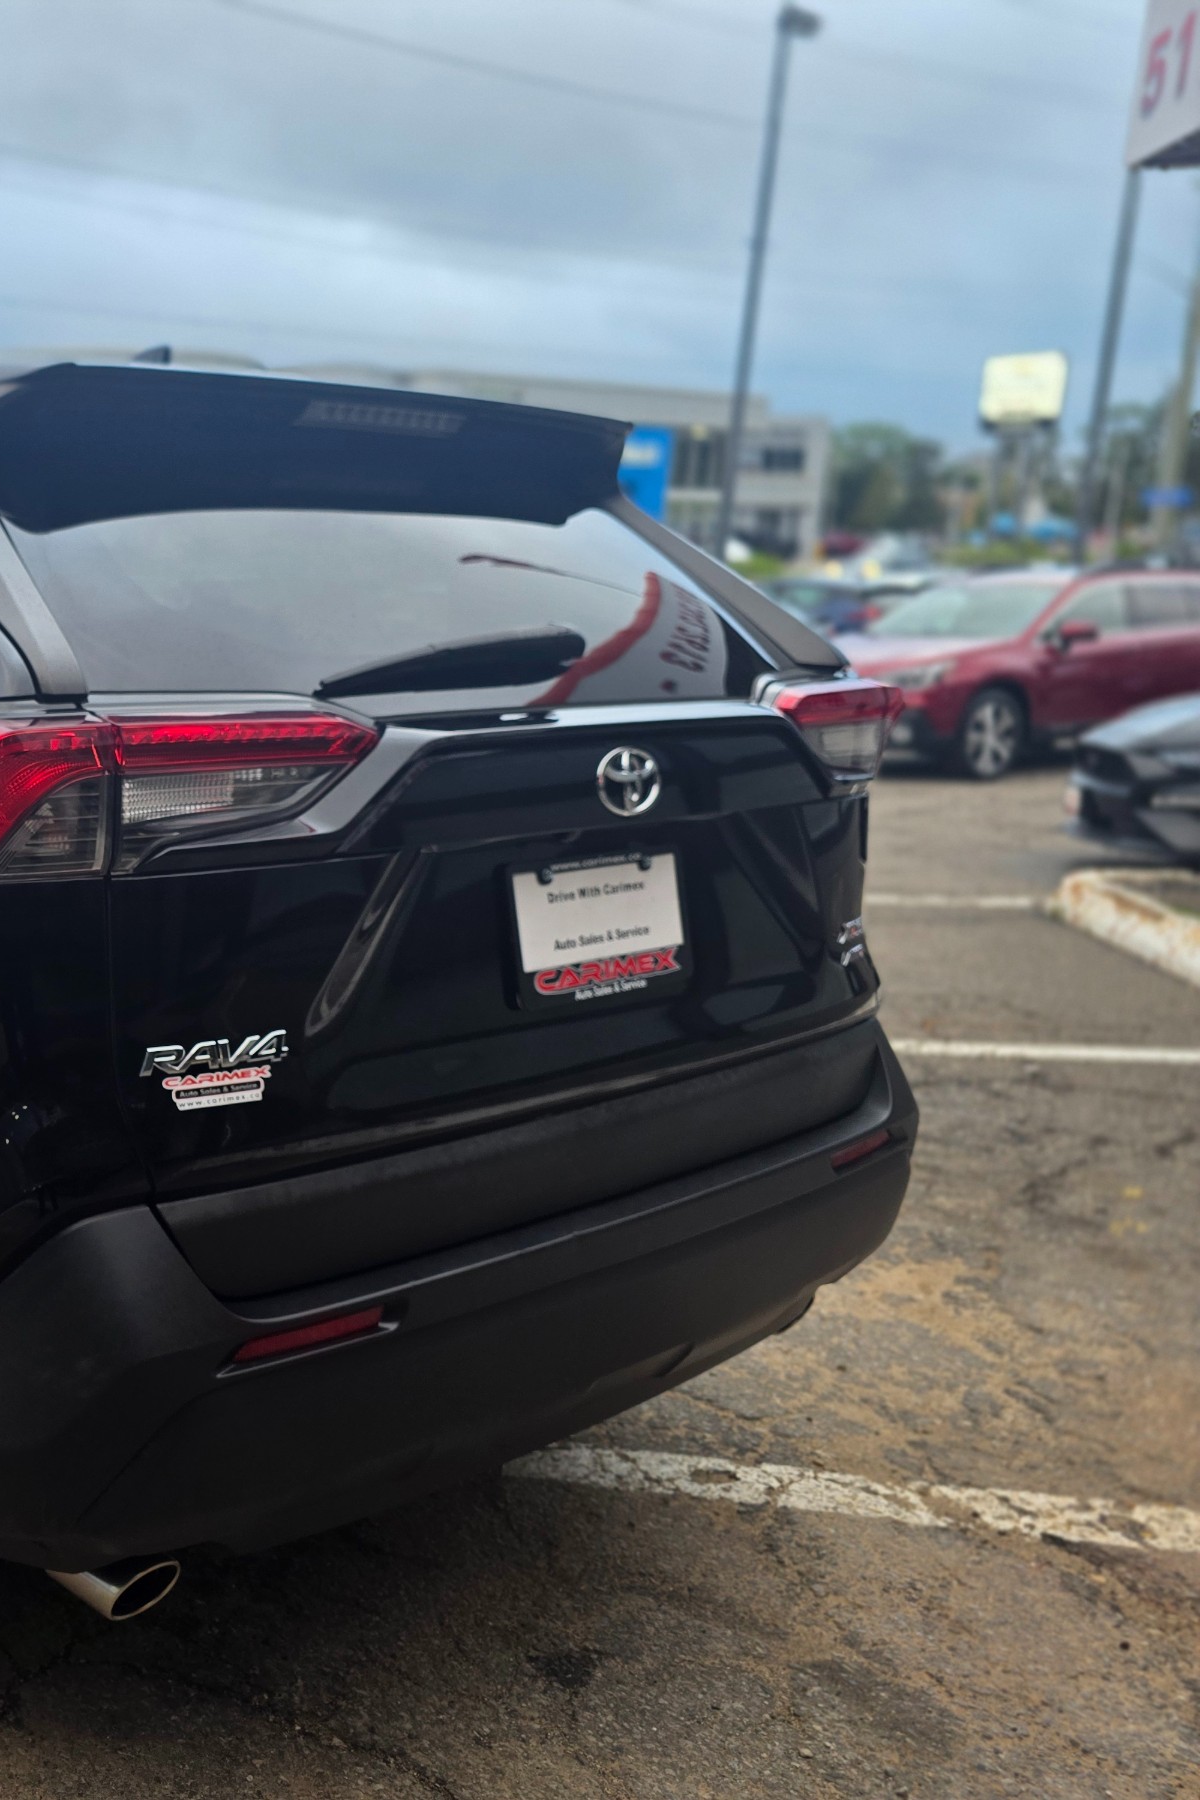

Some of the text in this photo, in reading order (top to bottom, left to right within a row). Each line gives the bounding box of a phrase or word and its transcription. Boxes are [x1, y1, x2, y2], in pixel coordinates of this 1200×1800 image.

[548, 881, 644, 903] Drive With Carimex
[554, 925, 649, 950] Auto Sales & Service
[535, 946, 680, 994] CARIMEX
[139, 1029, 290, 1077] RAV4
[164, 1067, 270, 1087] CARIMEX
[179, 1081, 259, 1098] Auto Sales & Service
